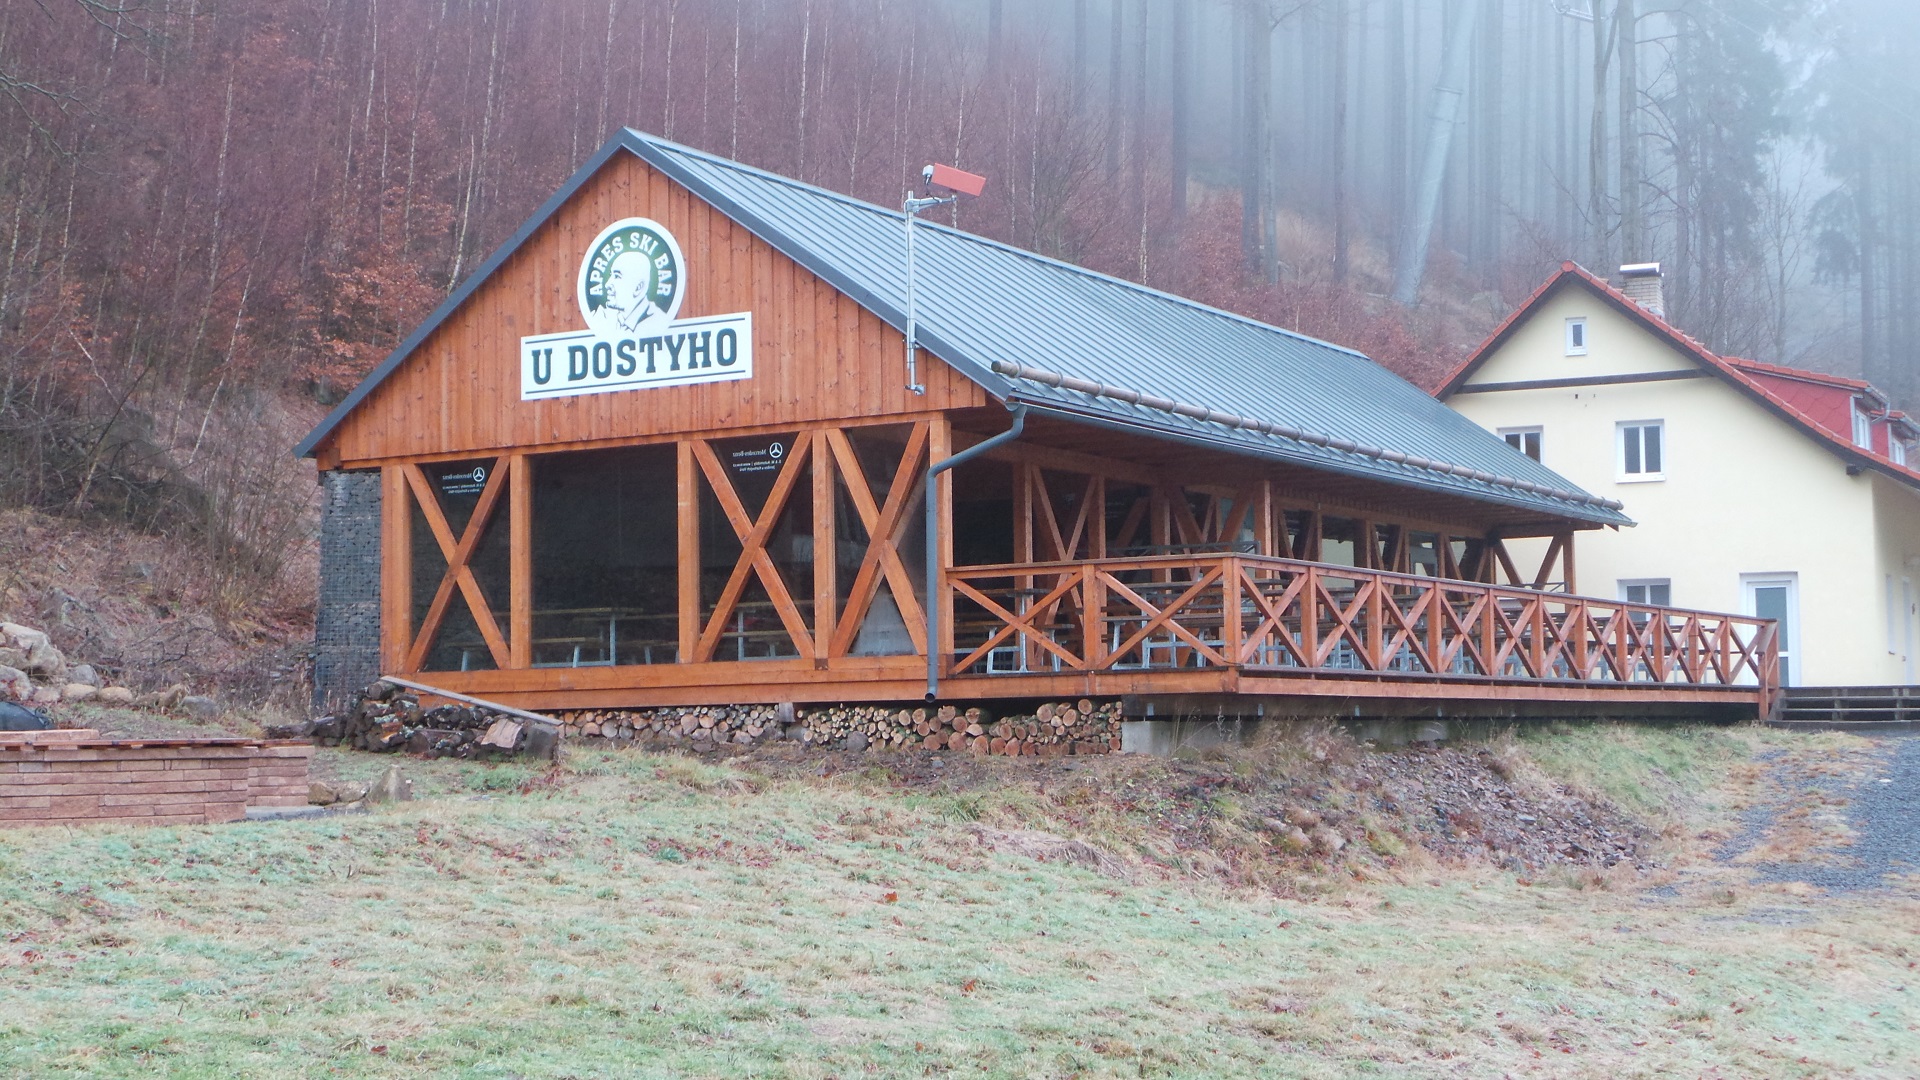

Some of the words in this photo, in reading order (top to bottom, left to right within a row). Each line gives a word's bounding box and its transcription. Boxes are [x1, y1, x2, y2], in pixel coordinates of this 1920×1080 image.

[589, 236, 624, 297] APRES
[629, 232, 658, 255] SKI
[654, 252, 672, 297] BAR
[531, 348, 553, 386] U
[567, 327, 738, 382] DOSTYHO
